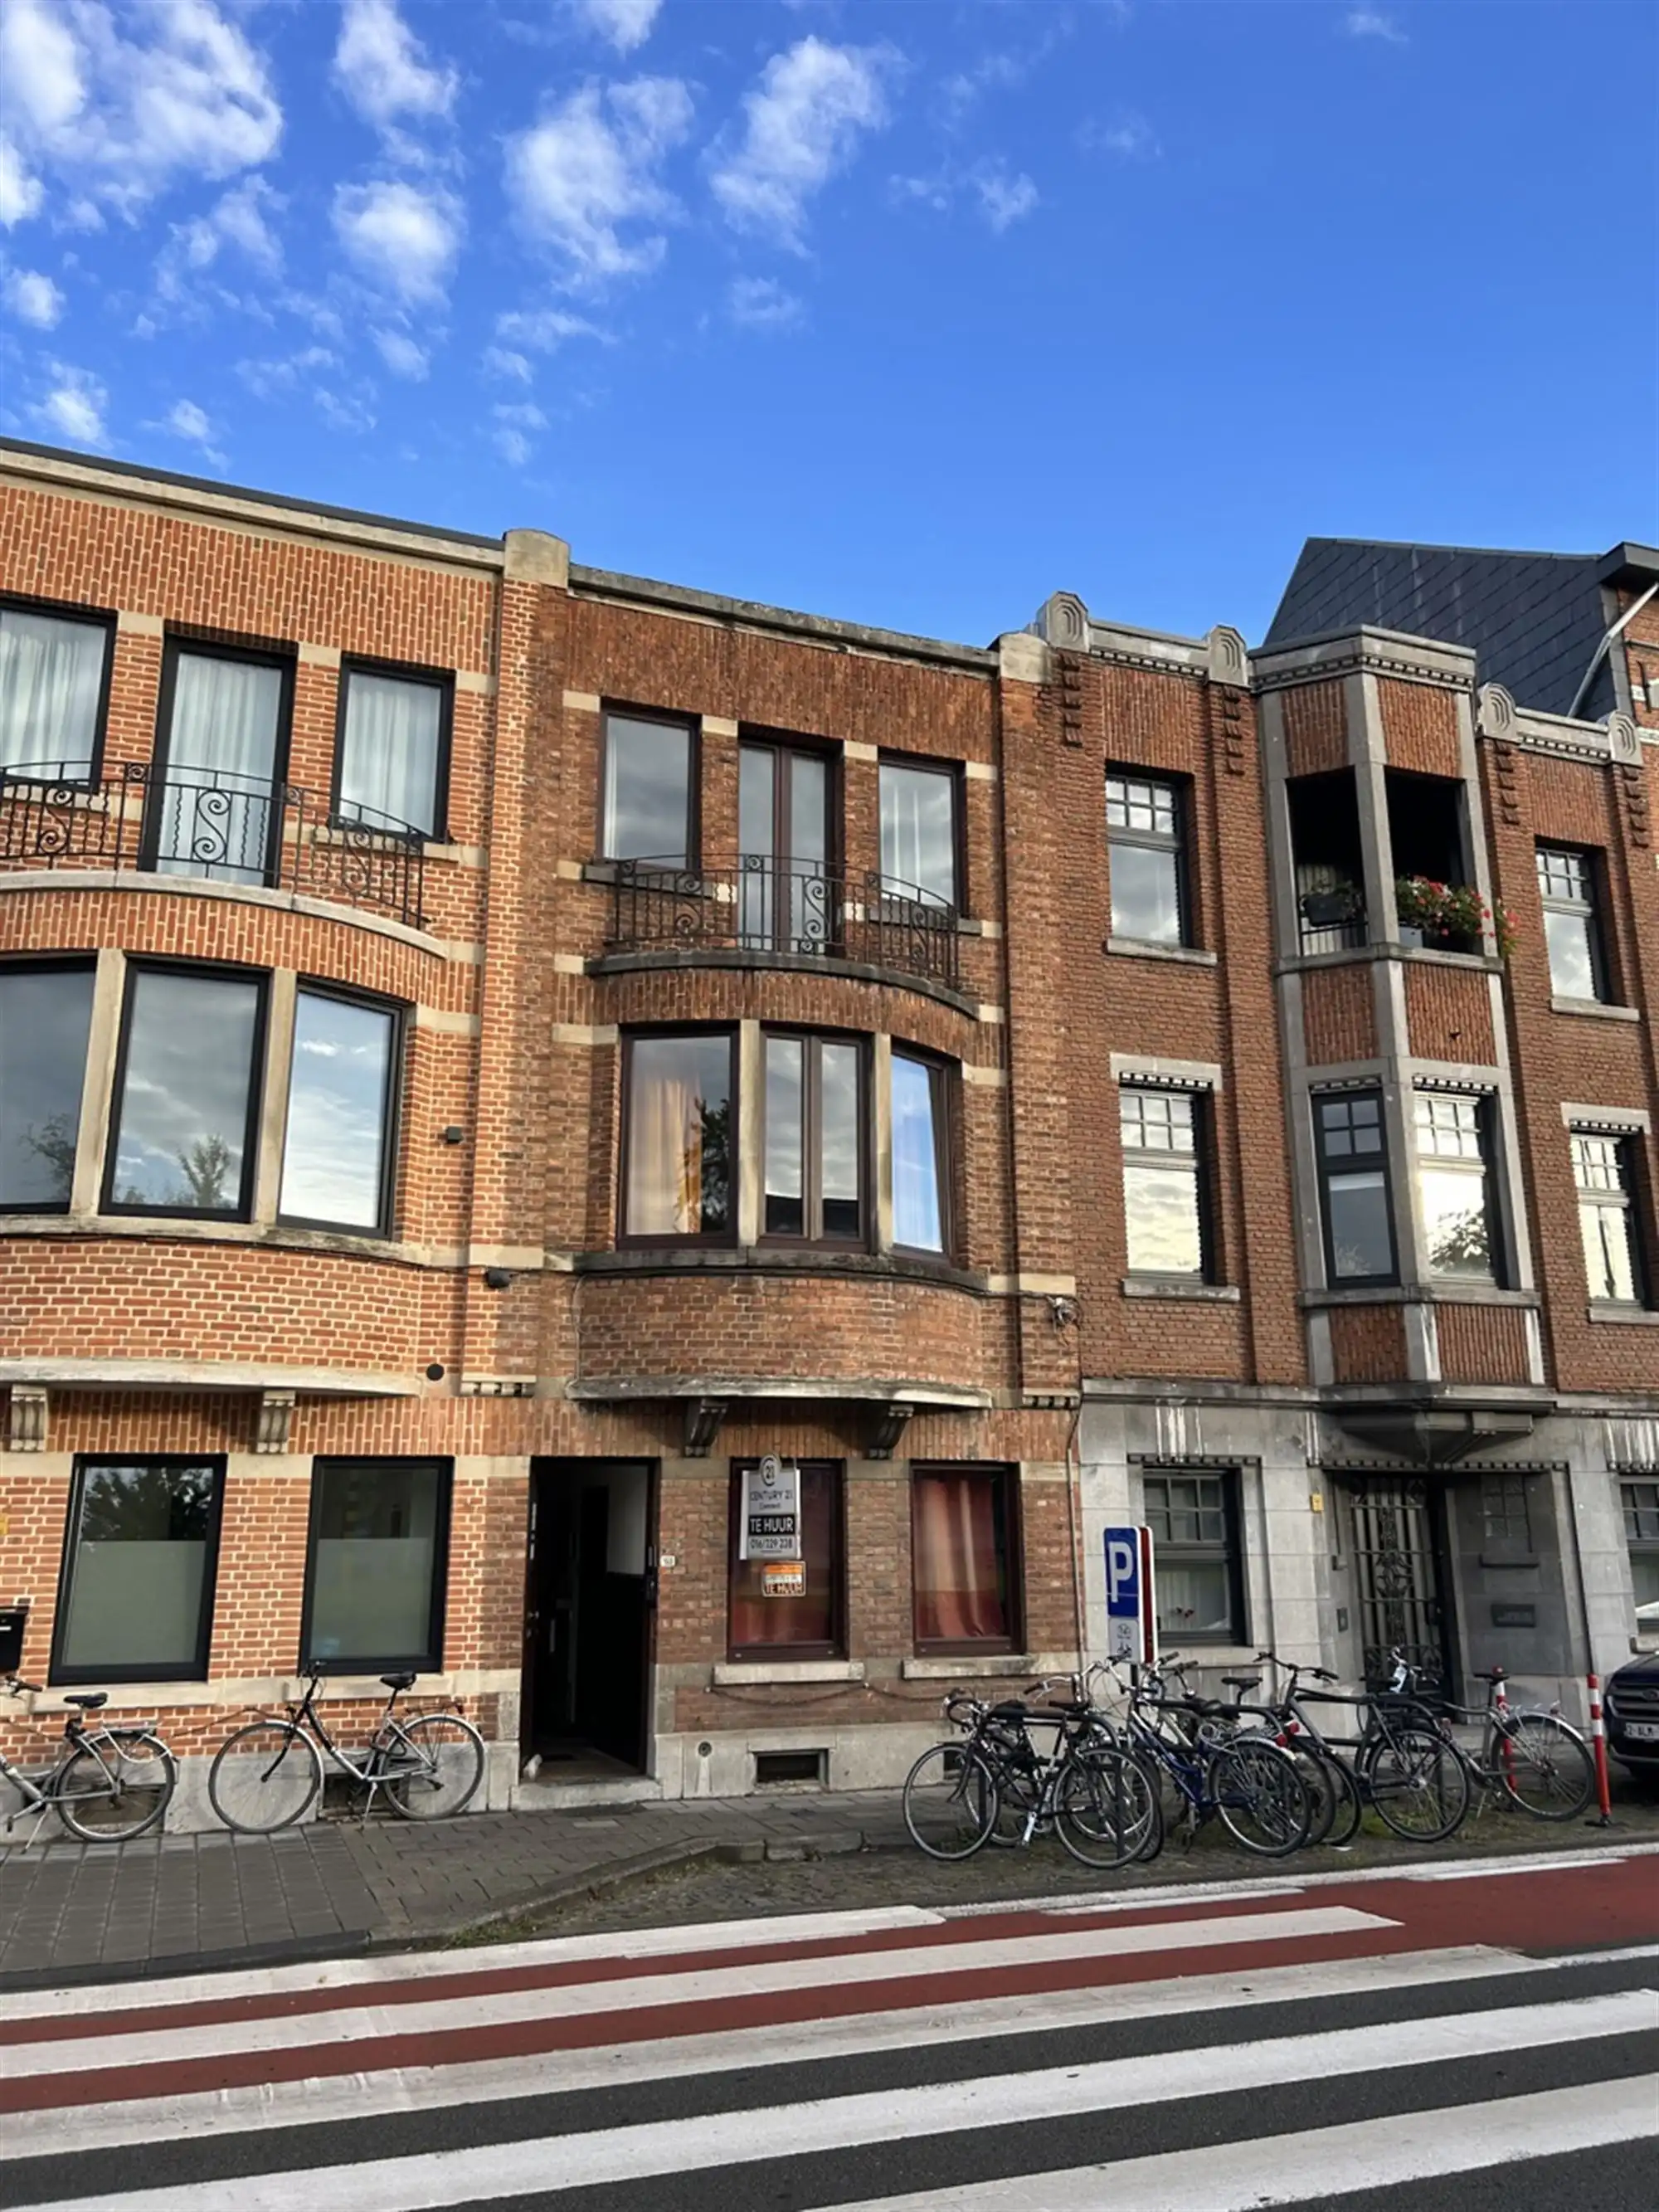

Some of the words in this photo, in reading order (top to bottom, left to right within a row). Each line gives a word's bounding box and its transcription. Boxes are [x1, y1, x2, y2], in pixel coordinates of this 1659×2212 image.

[749, 1490, 783, 1501] CENTURY
[750, 1518, 761, 1532] TE
[764, 1517, 794, 1532] HUUR
[1108, 1541, 1133, 1603] P
[766, 1584, 776, 1594] TE
